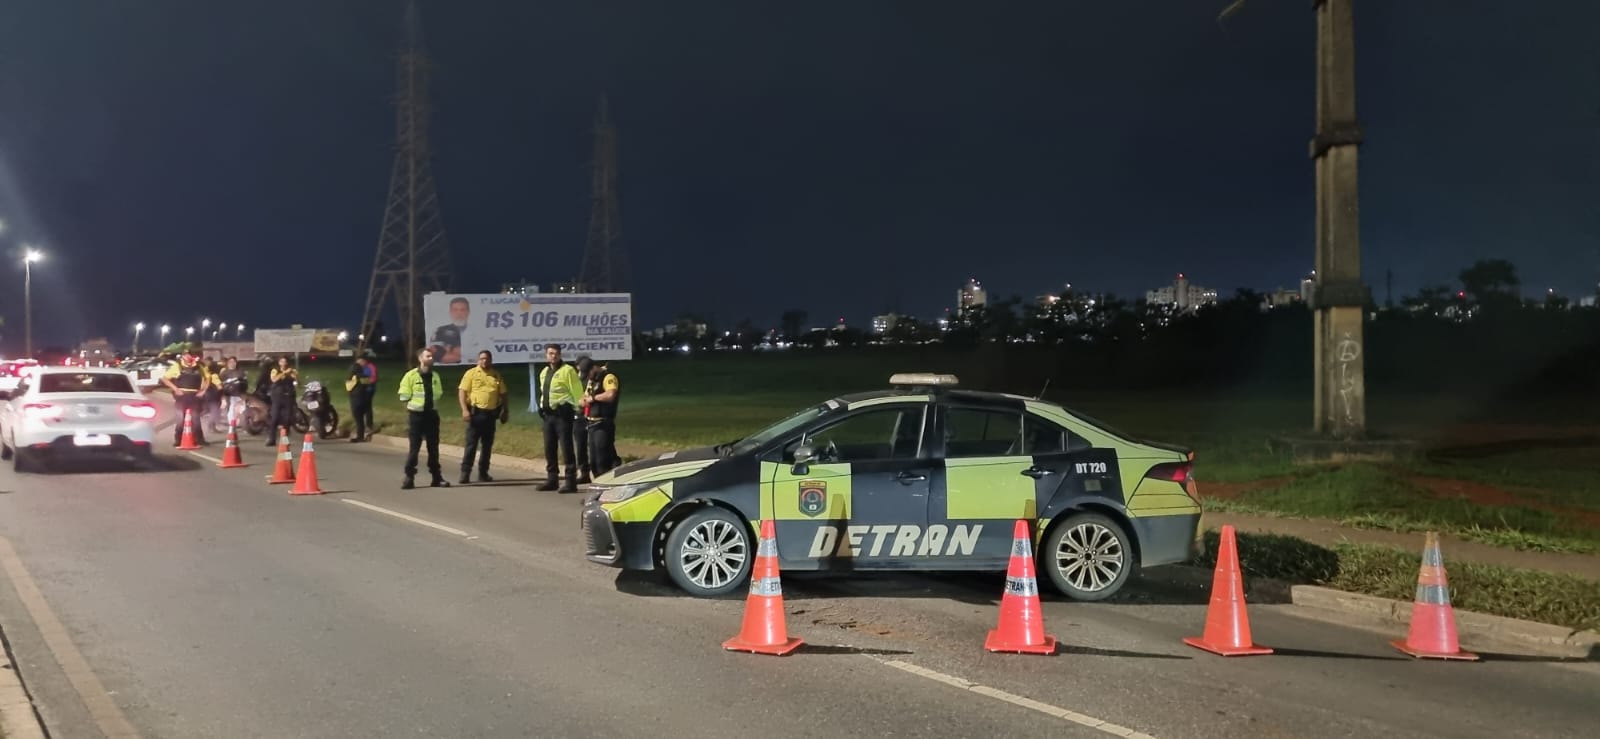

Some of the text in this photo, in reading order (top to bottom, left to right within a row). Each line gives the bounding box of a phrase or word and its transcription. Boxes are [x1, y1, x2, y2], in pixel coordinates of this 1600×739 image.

[485, 310, 627, 330] R$ 106 MILHÕES
[494, 341, 625, 352] VEIA D PACIENTE
[1089, 462, 1107, 473] 720
[808, 524, 984, 558] DETRAN
